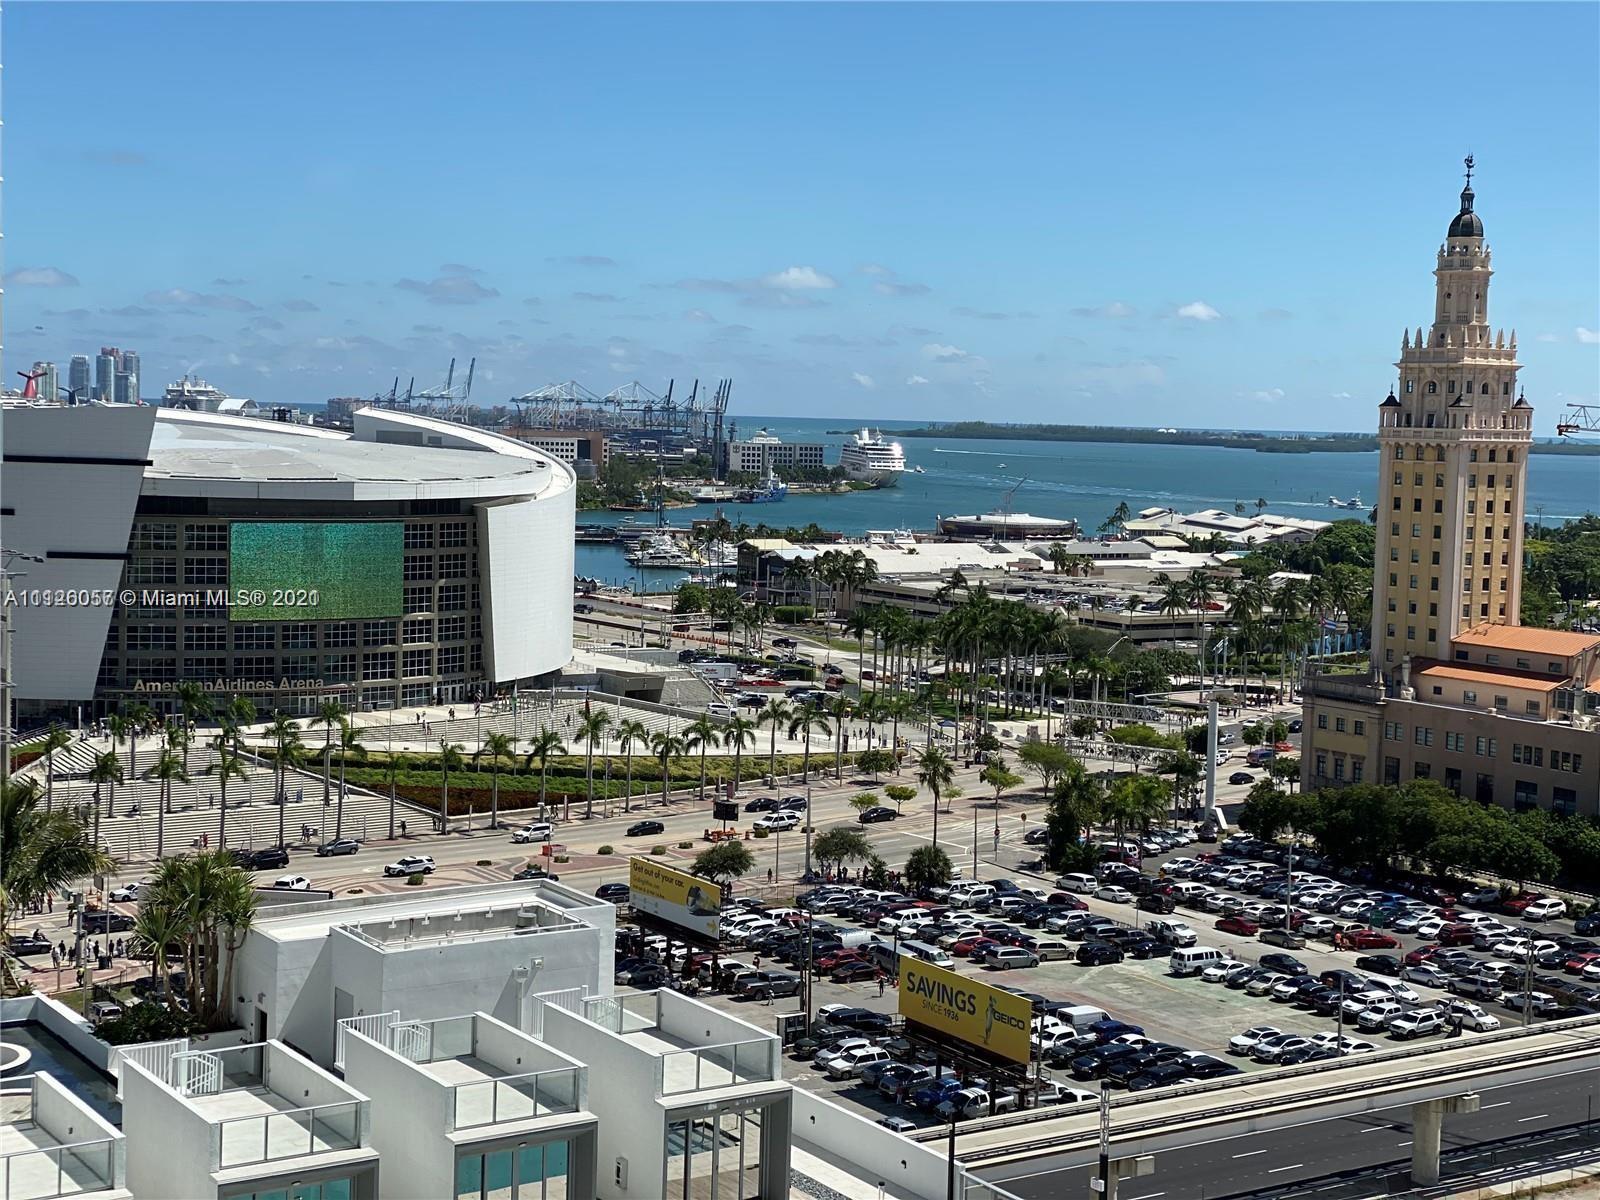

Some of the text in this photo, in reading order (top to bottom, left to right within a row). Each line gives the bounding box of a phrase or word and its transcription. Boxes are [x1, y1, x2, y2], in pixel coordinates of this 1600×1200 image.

[279, 677, 324, 690] Arena
[633, 862, 644, 873] Get
[644, 868, 654, 877] out
[654, 870, 661, 879] of
[661, 873, 674, 884] your
[906, 971, 977, 1016] SAVINGS
[921, 1000, 960, 1022] SINCE 1936
[993, 1009, 1025, 1031] GEICO
